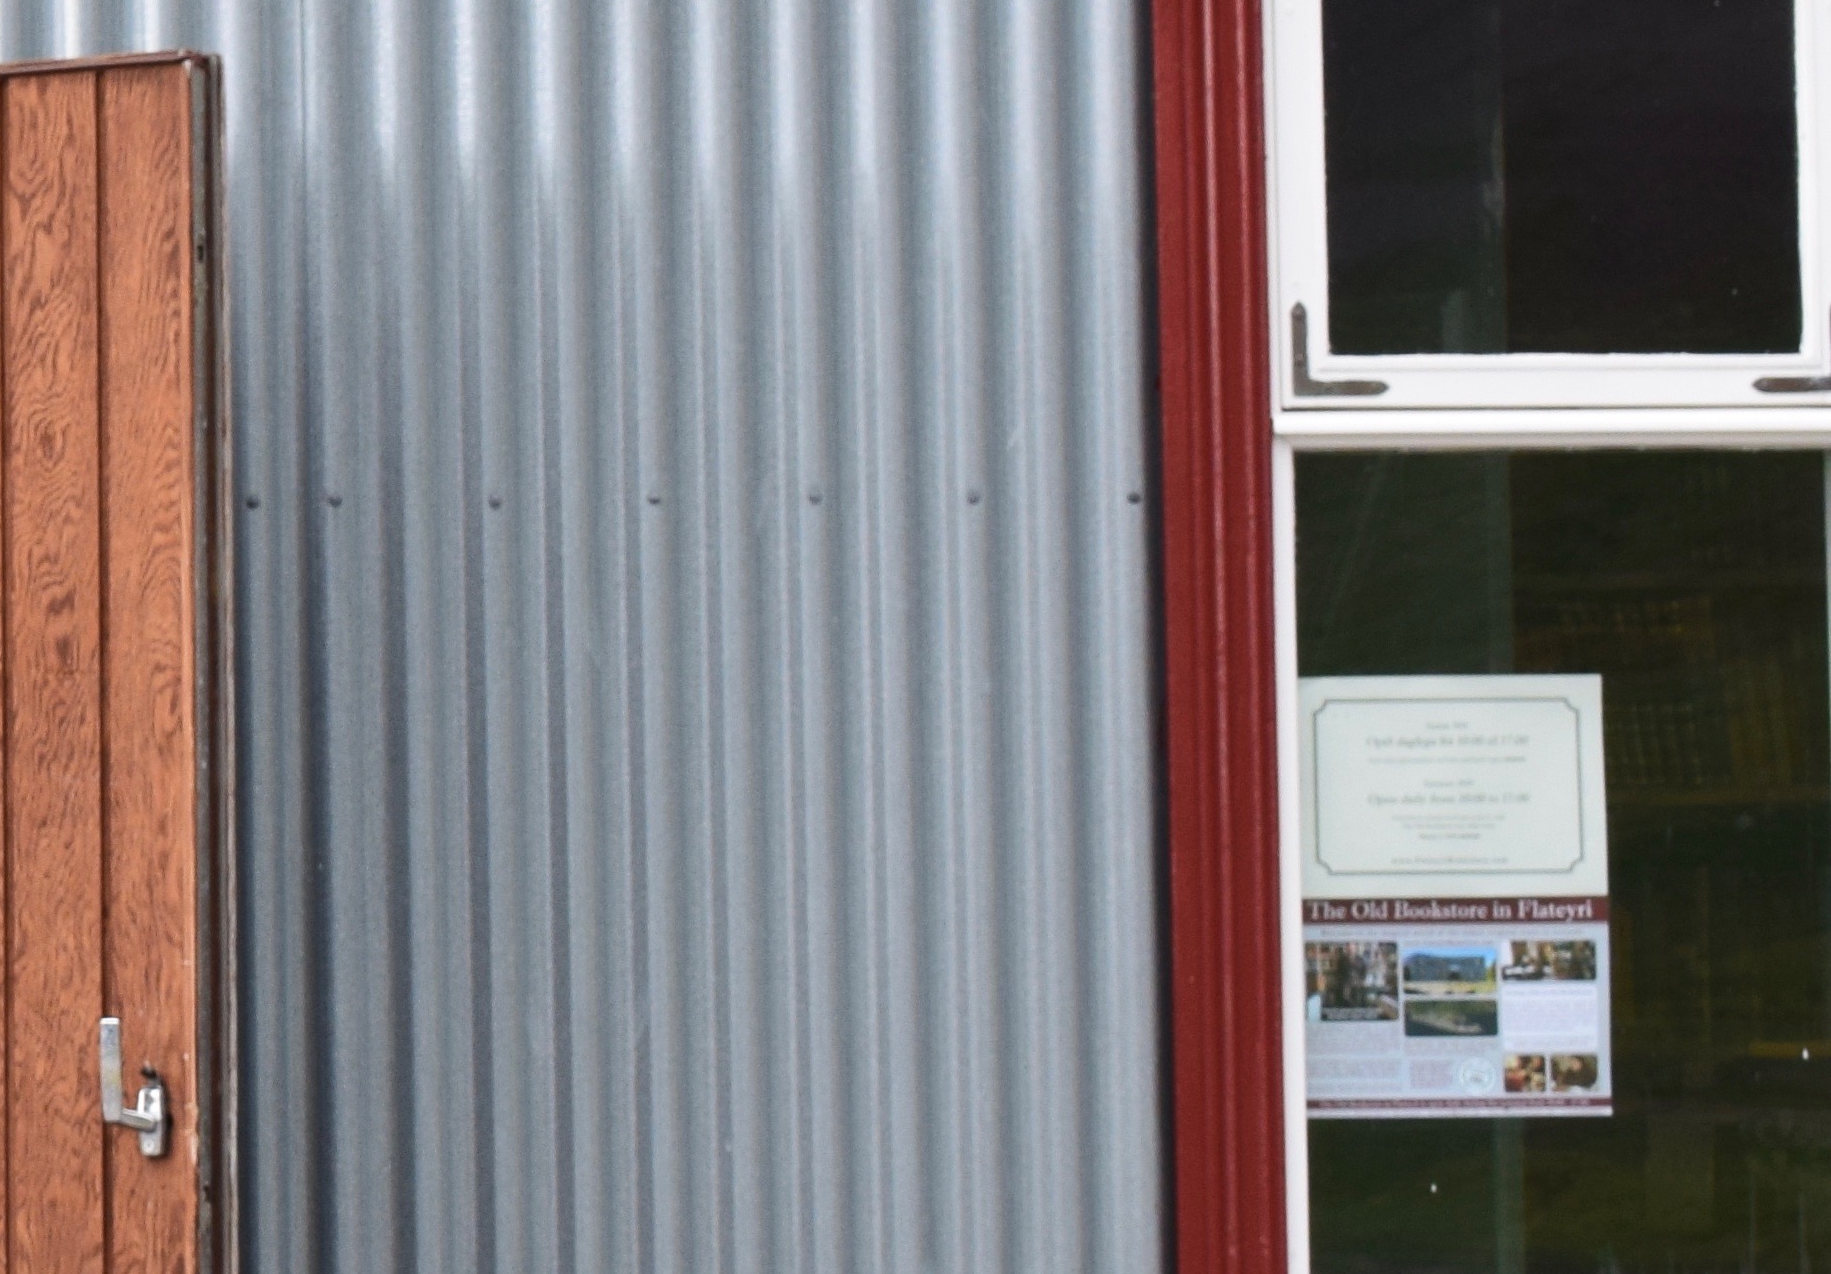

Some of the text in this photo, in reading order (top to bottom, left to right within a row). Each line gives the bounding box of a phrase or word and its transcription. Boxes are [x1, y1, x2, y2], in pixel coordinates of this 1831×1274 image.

[1308, 897, 1593, 922] The Old Bookstore in Flateyri
